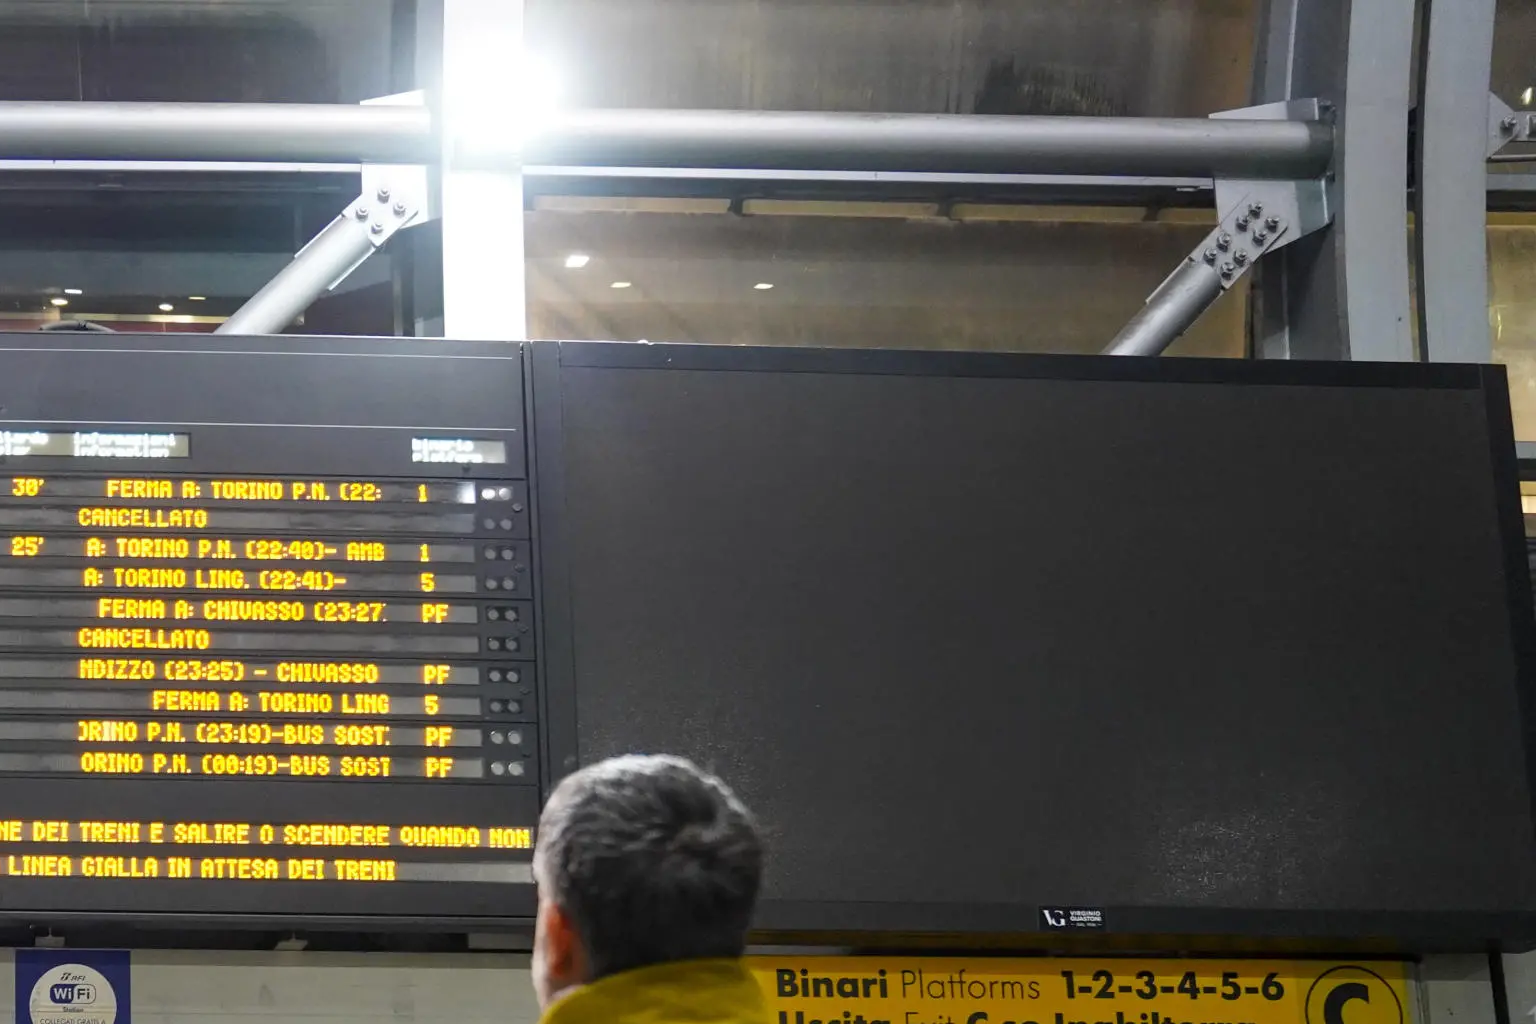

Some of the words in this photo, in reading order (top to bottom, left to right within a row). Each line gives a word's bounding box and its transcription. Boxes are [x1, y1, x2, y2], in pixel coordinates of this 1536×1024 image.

[13, 479, 44, 496] 30'
[107, 480, 172, 498] FERMA
[182, 481, 200, 497] A:
[211, 482, 282, 499] TORINO
[293, 483, 328, 500] P.N.
[79, 508, 208, 528] CANCELLATO
[12, 537, 43, 555] 25'
[87, 538, 106, 556] A:
[116, 538, 189, 558] TORINO
[198, 540, 236, 558] P.N.
[84, 568, 103, 586] A:
[114, 568, 186, 587] TORINO
[196, 570, 249, 589] LING.
[98, 599, 166, 618] FERMA
[174, 600, 194, 619] A:
[422, 604, 448, 622] PF
[78, 628, 210, 649] CANCELLATO
[165, 661, 244, 680] (23:25)
[423, 665, 448, 684] PF
[153, 691, 220, 710] FERMA
[229, 692, 248, 711] A:
[259, 692, 332, 712] TORINO
[147, 722, 186, 742] P.N.
[425, 727, 452, 746] PF
[81, 752, 143, 772] ORINO
[153, 754, 191, 773] P.N.
[425, 757, 453, 777] PF
[32, 822, 69, 841] DEI
[79, 822, 140, 842] TRENI
[174, 824, 250, 844] SALIRE
[284, 825, 390, 845] SCENDERE
[400, 826, 480, 847] QUANDO
[488, 829, 530, 848] NON
[8, 856, 72, 876] LINEA
[81, 857, 160, 877] GIALLA
[168, 857, 191, 877] IN
[201, 859, 279, 878] ATTESA
[288, 859, 324, 879] DEI
[334, 860, 395, 880] TRENI
[777, 969, 888, 999] Binari
[901, 969, 1040, 1000] Platforms
[1061, 970, 1285, 1000] 1-2-3-4-5-6
